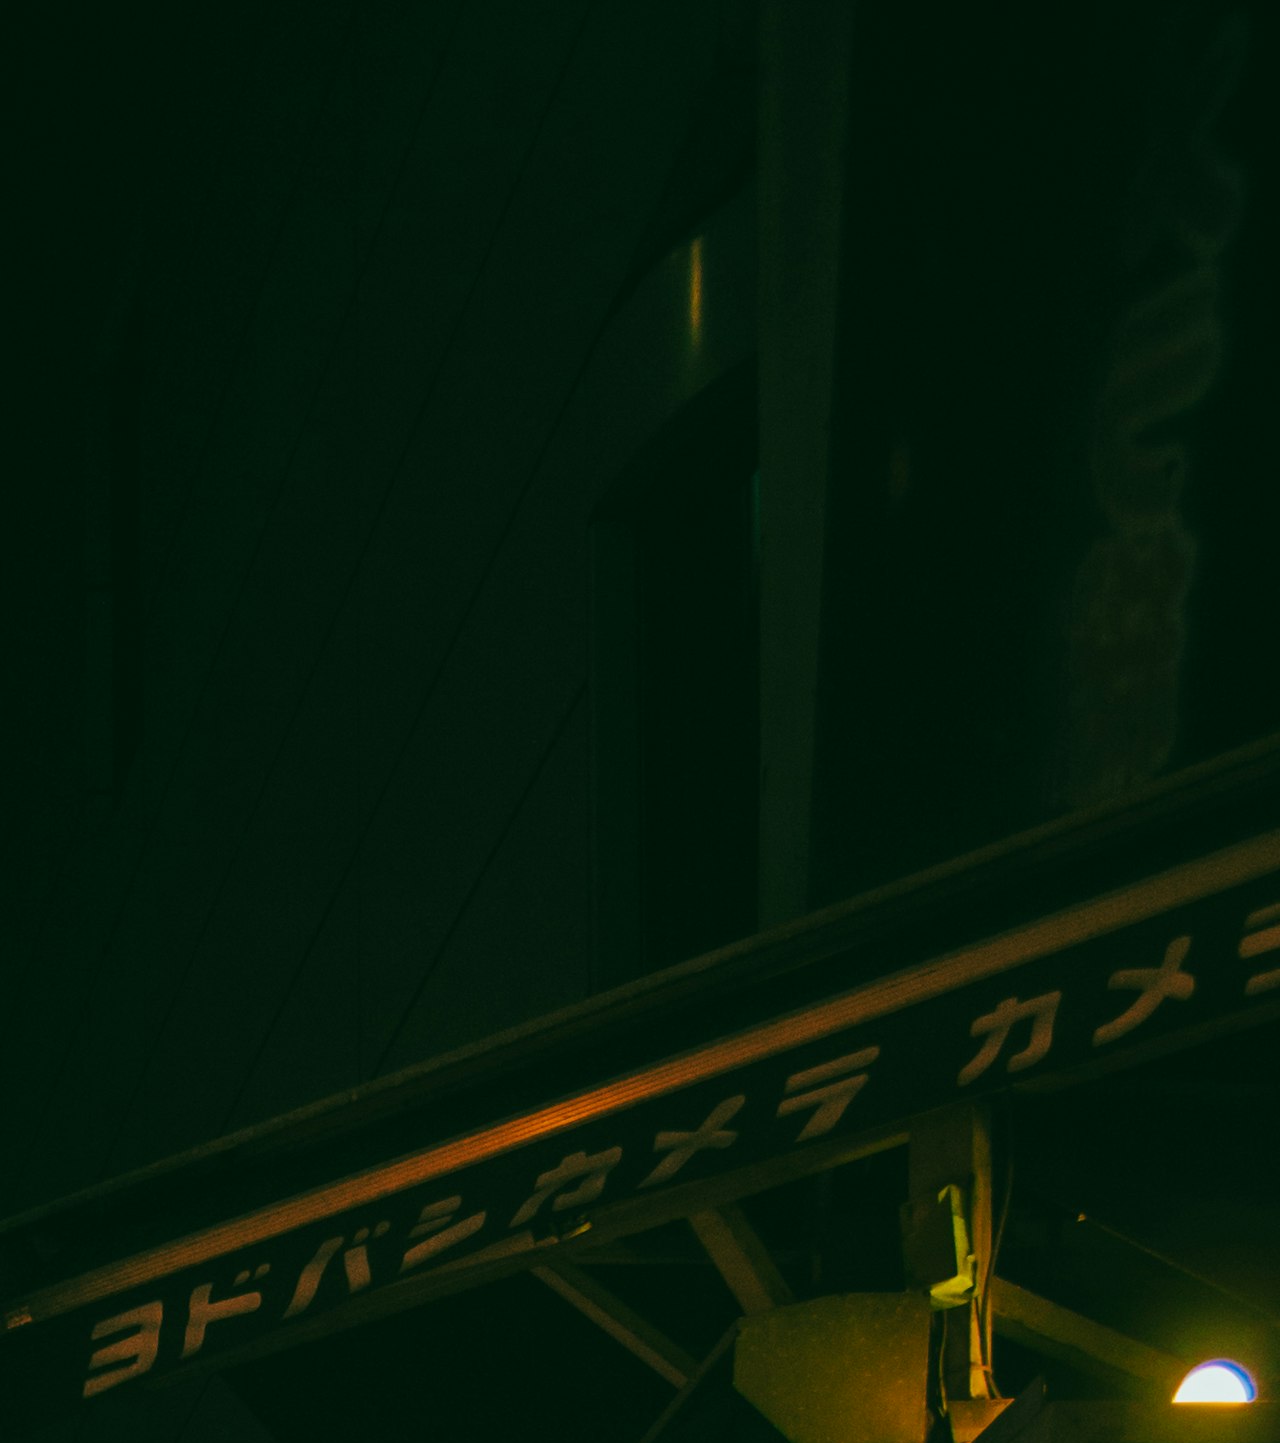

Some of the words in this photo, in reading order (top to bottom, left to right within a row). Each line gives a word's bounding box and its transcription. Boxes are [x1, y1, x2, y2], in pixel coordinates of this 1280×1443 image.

[82, 1045, 880, 1398] ヨドバシカメラ
